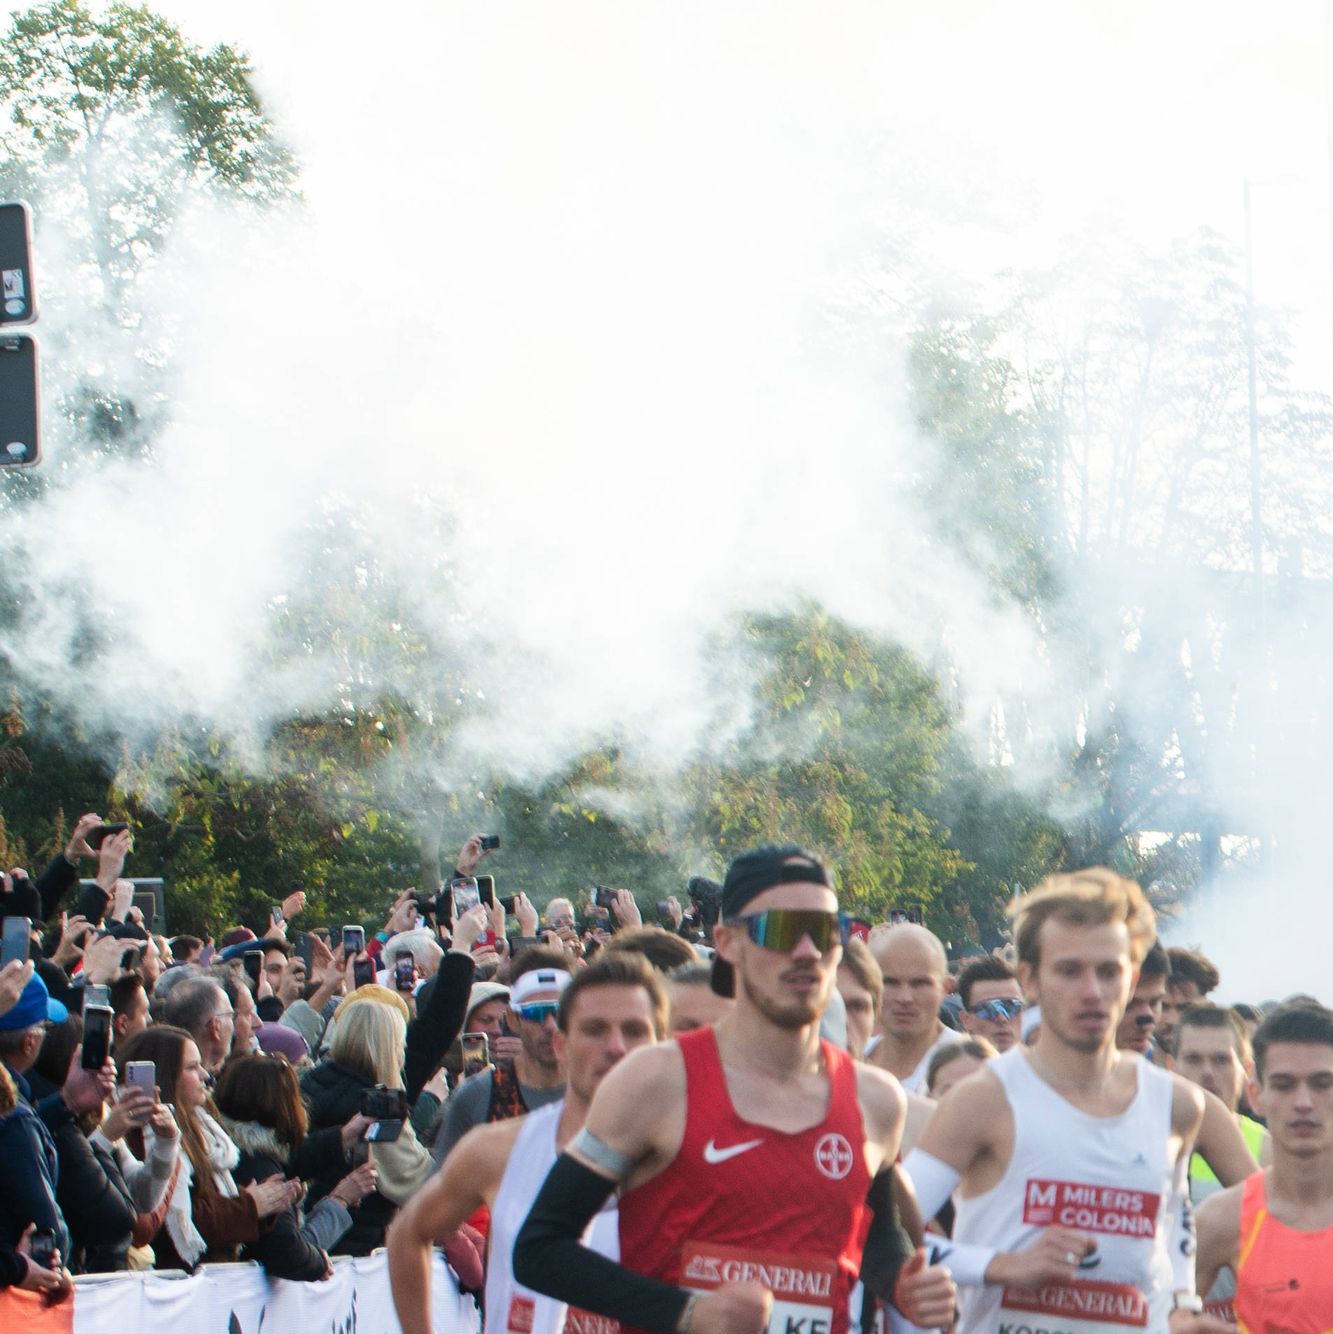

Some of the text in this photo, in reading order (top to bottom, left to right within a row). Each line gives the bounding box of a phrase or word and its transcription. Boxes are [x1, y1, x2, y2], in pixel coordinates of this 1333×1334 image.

[1063, 1186, 1143, 1213] MILERS
[721, 1259, 832, 1297] GENERALI
[1039, 1285, 1145, 1319] GENERALI
